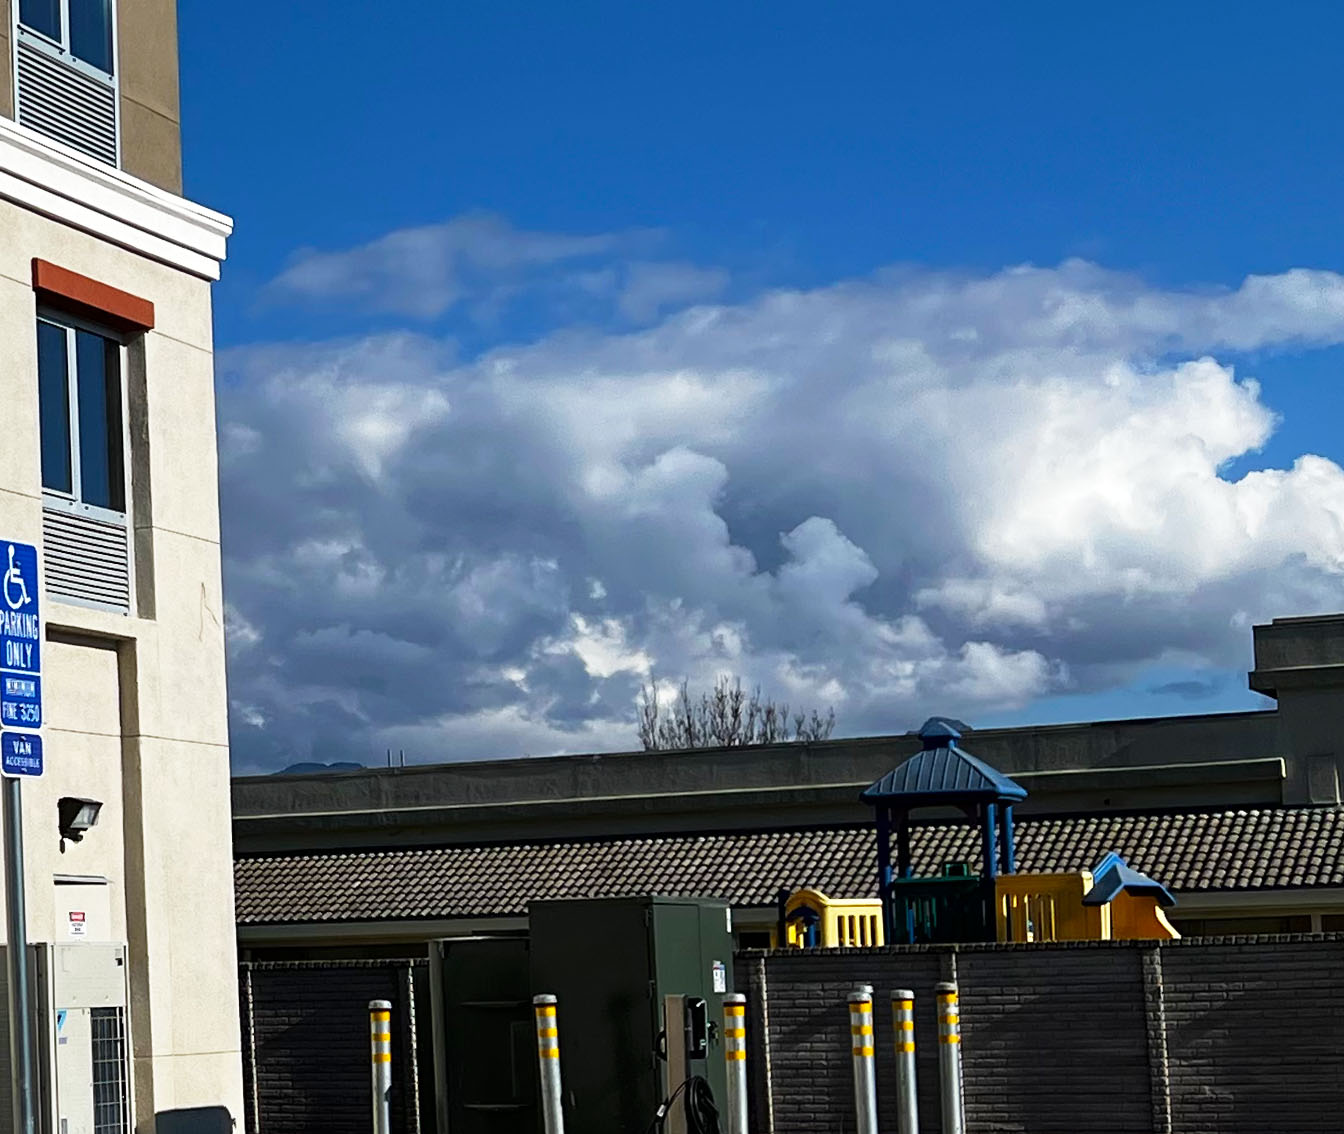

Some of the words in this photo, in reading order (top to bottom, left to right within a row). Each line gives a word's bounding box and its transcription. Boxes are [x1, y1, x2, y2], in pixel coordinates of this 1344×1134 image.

[0, 609, 38, 639] PARKING
[6, 640, 32, 668] ONLY
[12, 740, 32, 755] VAN
